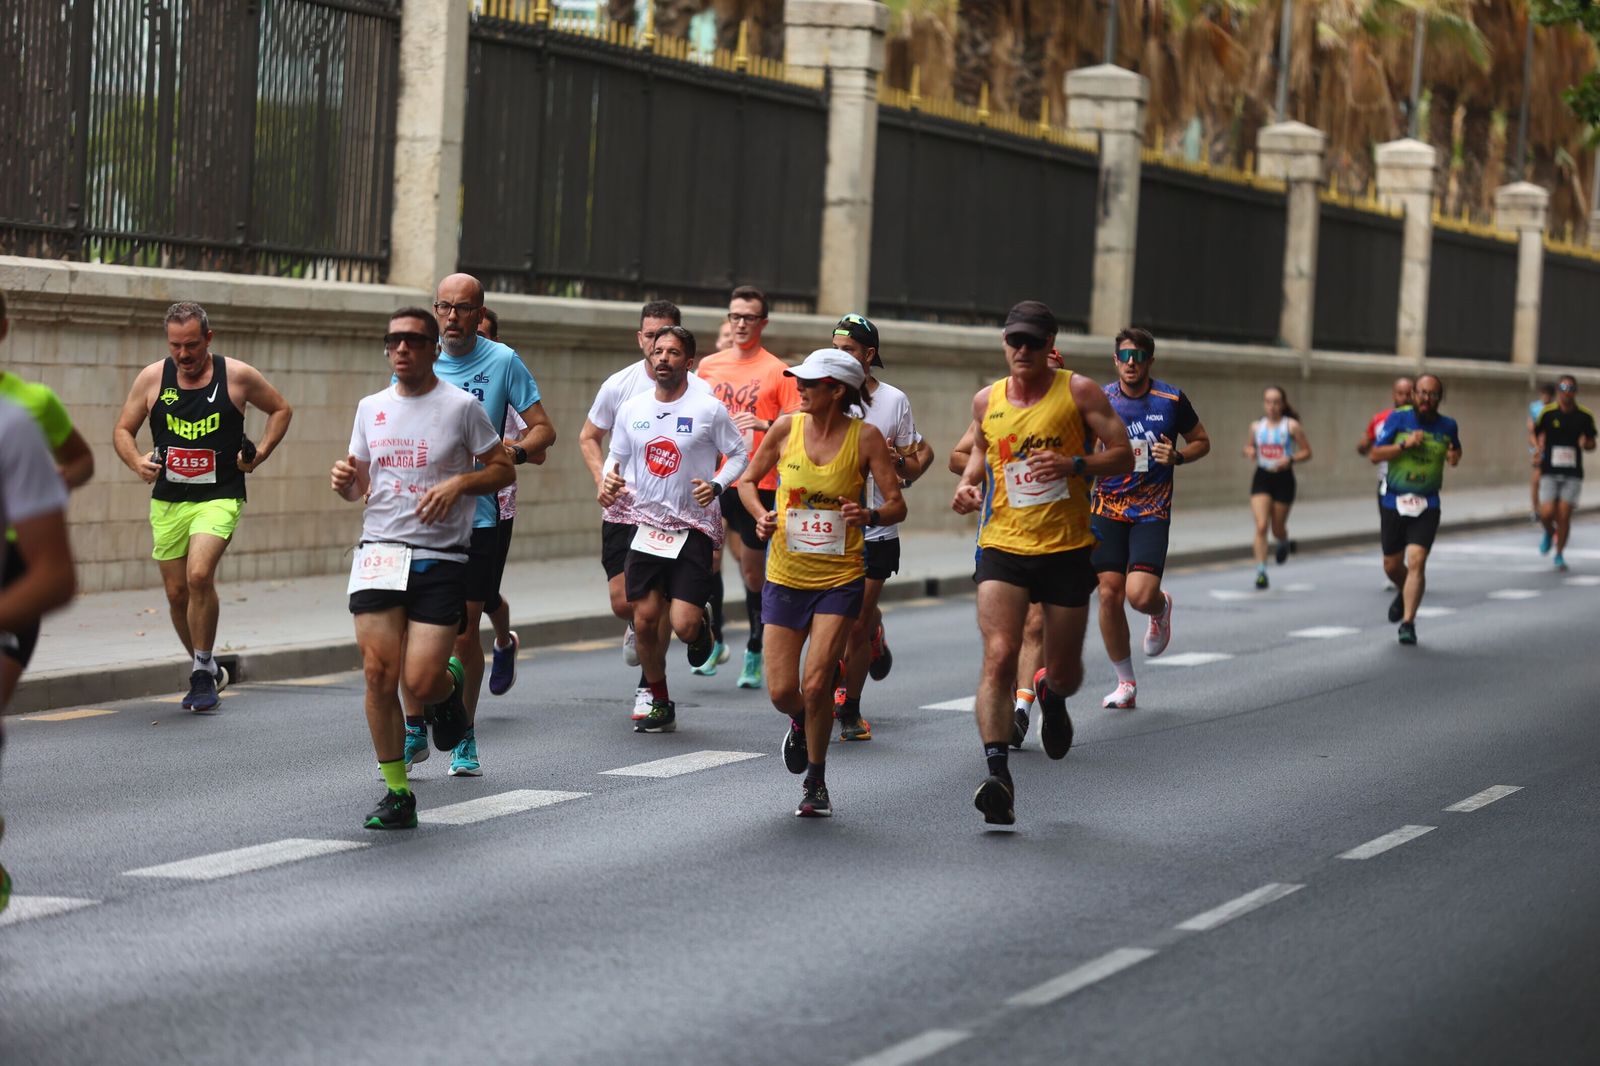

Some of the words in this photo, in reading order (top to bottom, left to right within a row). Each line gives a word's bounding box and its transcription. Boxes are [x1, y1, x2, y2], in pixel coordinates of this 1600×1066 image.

[1145, 414, 1164, 422] HOKA
[165, 412, 220, 441] NBRO
[676, 424, 690, 432] AXA
[378, 439, 415, 447] GENERALI
[649, 446, 677, 461] PONLE
[172, 457, 209, 467] 2153
[648, 453, 675, 468] FRENO
[801, 521, 833, 533] 143
[648, 530, 675, 544] 400
